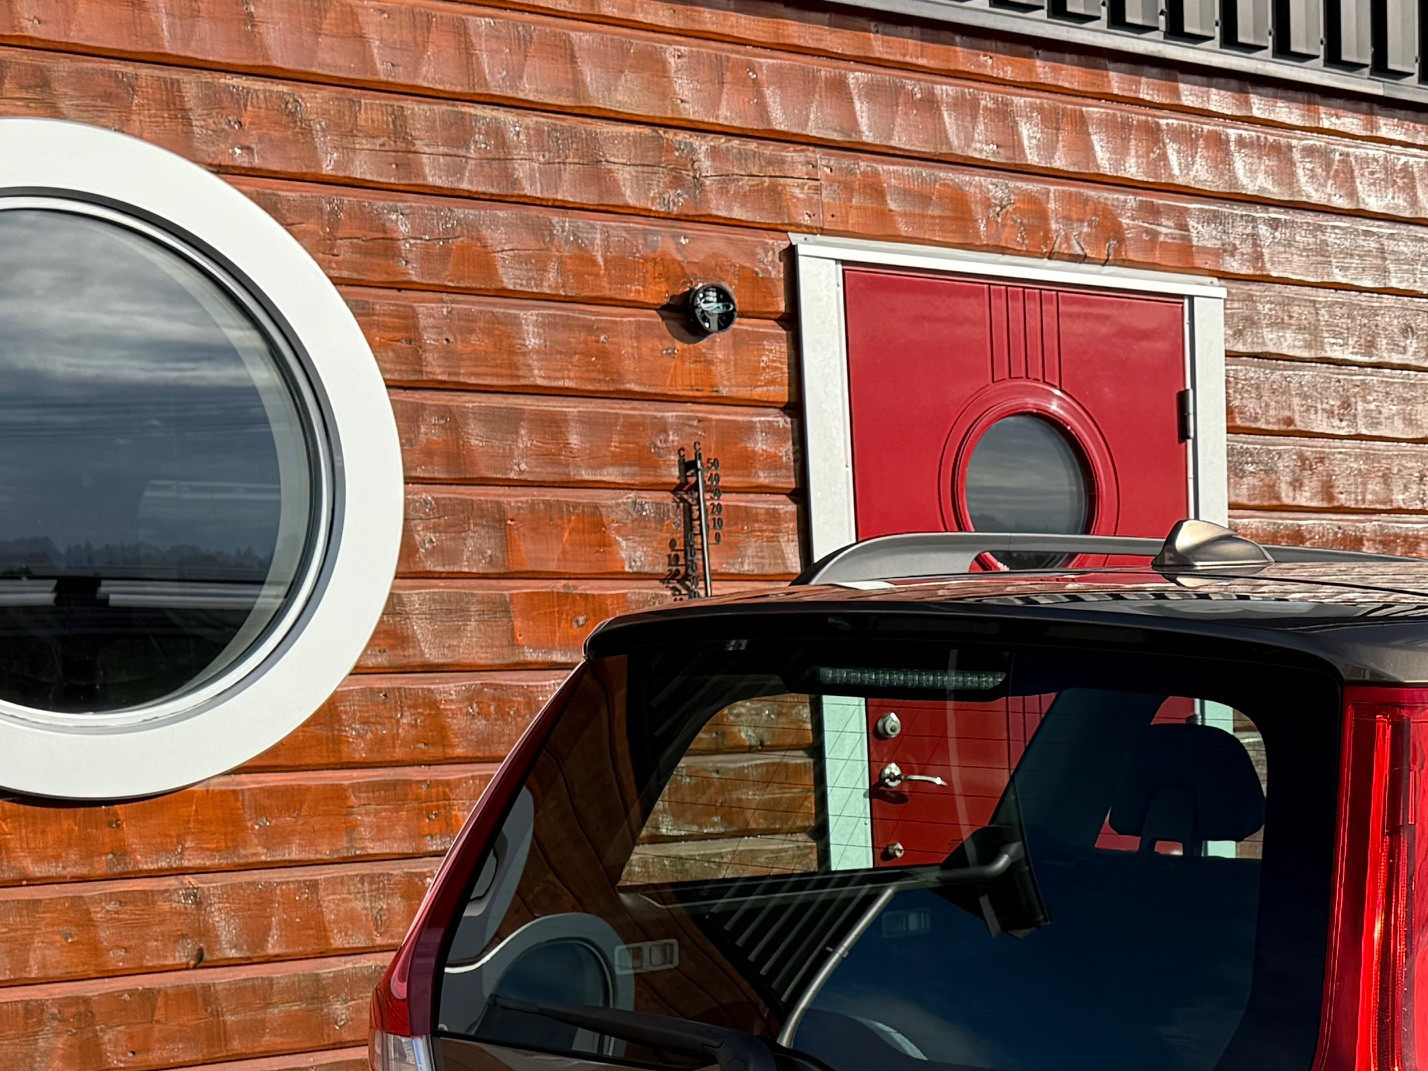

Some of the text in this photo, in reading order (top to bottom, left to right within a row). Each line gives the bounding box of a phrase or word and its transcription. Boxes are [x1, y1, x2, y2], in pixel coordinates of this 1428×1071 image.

[707, 457, 720, 470] 50
[708, 473, 720, 485] 40
[710, 502, 722, 515] 20
[712, 517, 723, 529] 10
[715, 532, 721, 544] 0
